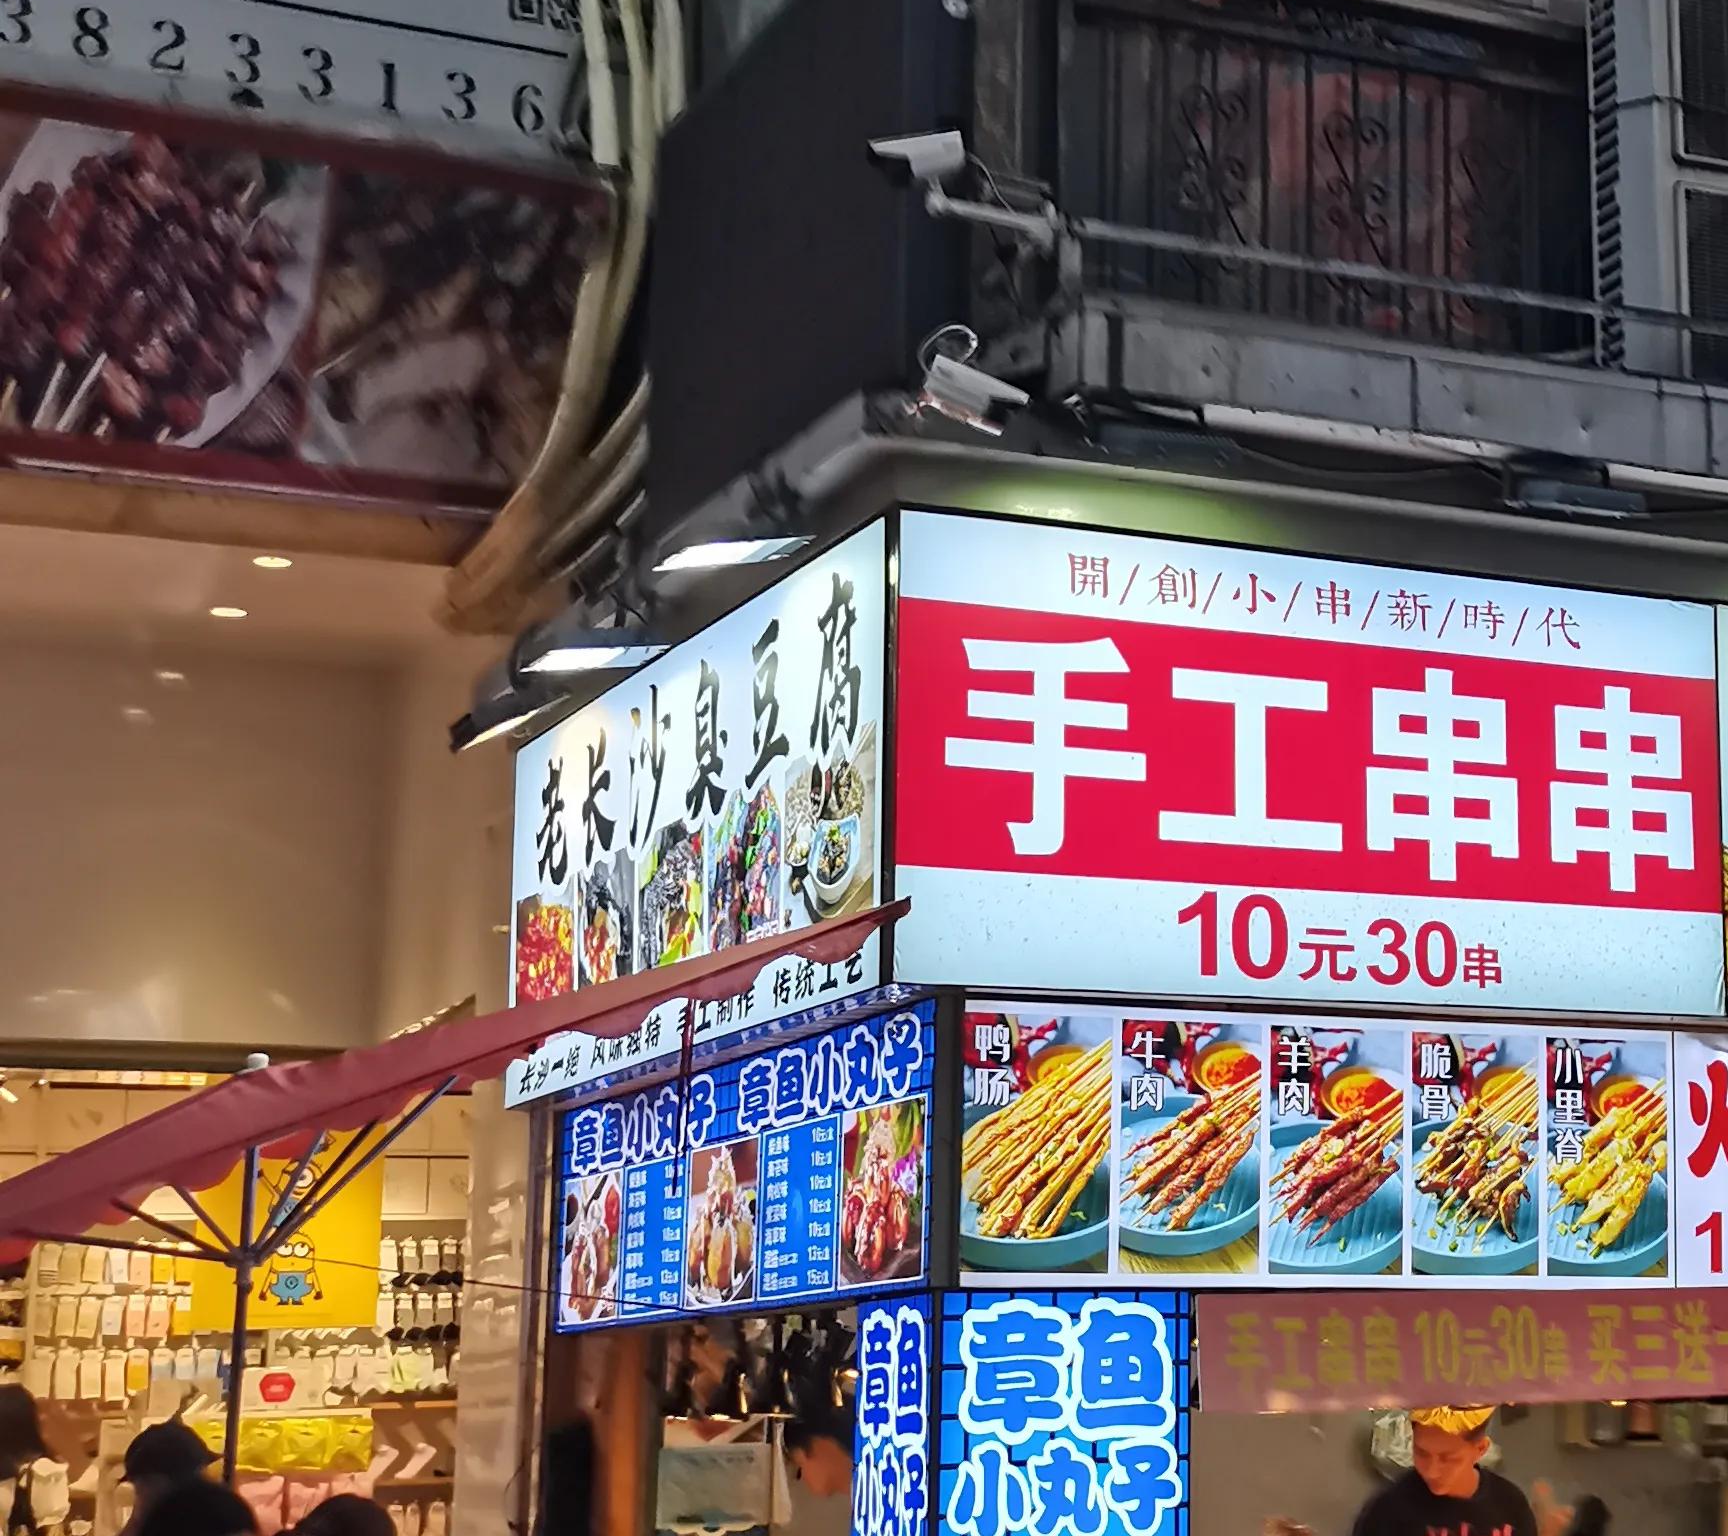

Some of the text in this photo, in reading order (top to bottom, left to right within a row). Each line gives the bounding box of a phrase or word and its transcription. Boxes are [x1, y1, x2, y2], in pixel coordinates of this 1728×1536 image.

[535, 572, 862, 887] 老长沙臭豆腐
[944, 636, 1698, 894] 手工串串
[1176, 889, 1504, 991] 10元30串
[737, 1021, 923, 1135] 章鱼小丸子
[972, 1022, 1012, 1107] 鸭肠
[1128, 1030, 1166, 1113] 牛肉
[1277, 1035, 1313, 1117] 羊肉
[1419, 1040, 1453, 1122] 脆骨
[1553, 1046, 1586, 1166] 小里脊
[571, 1073, 717, 1175] 章鱼小丸子
[860, 1304, 928, 1451] 章鱼
[959, 1296, 1174, 1446] 章鱼
[1224, 1305, 1402, 1394] 手工串串
